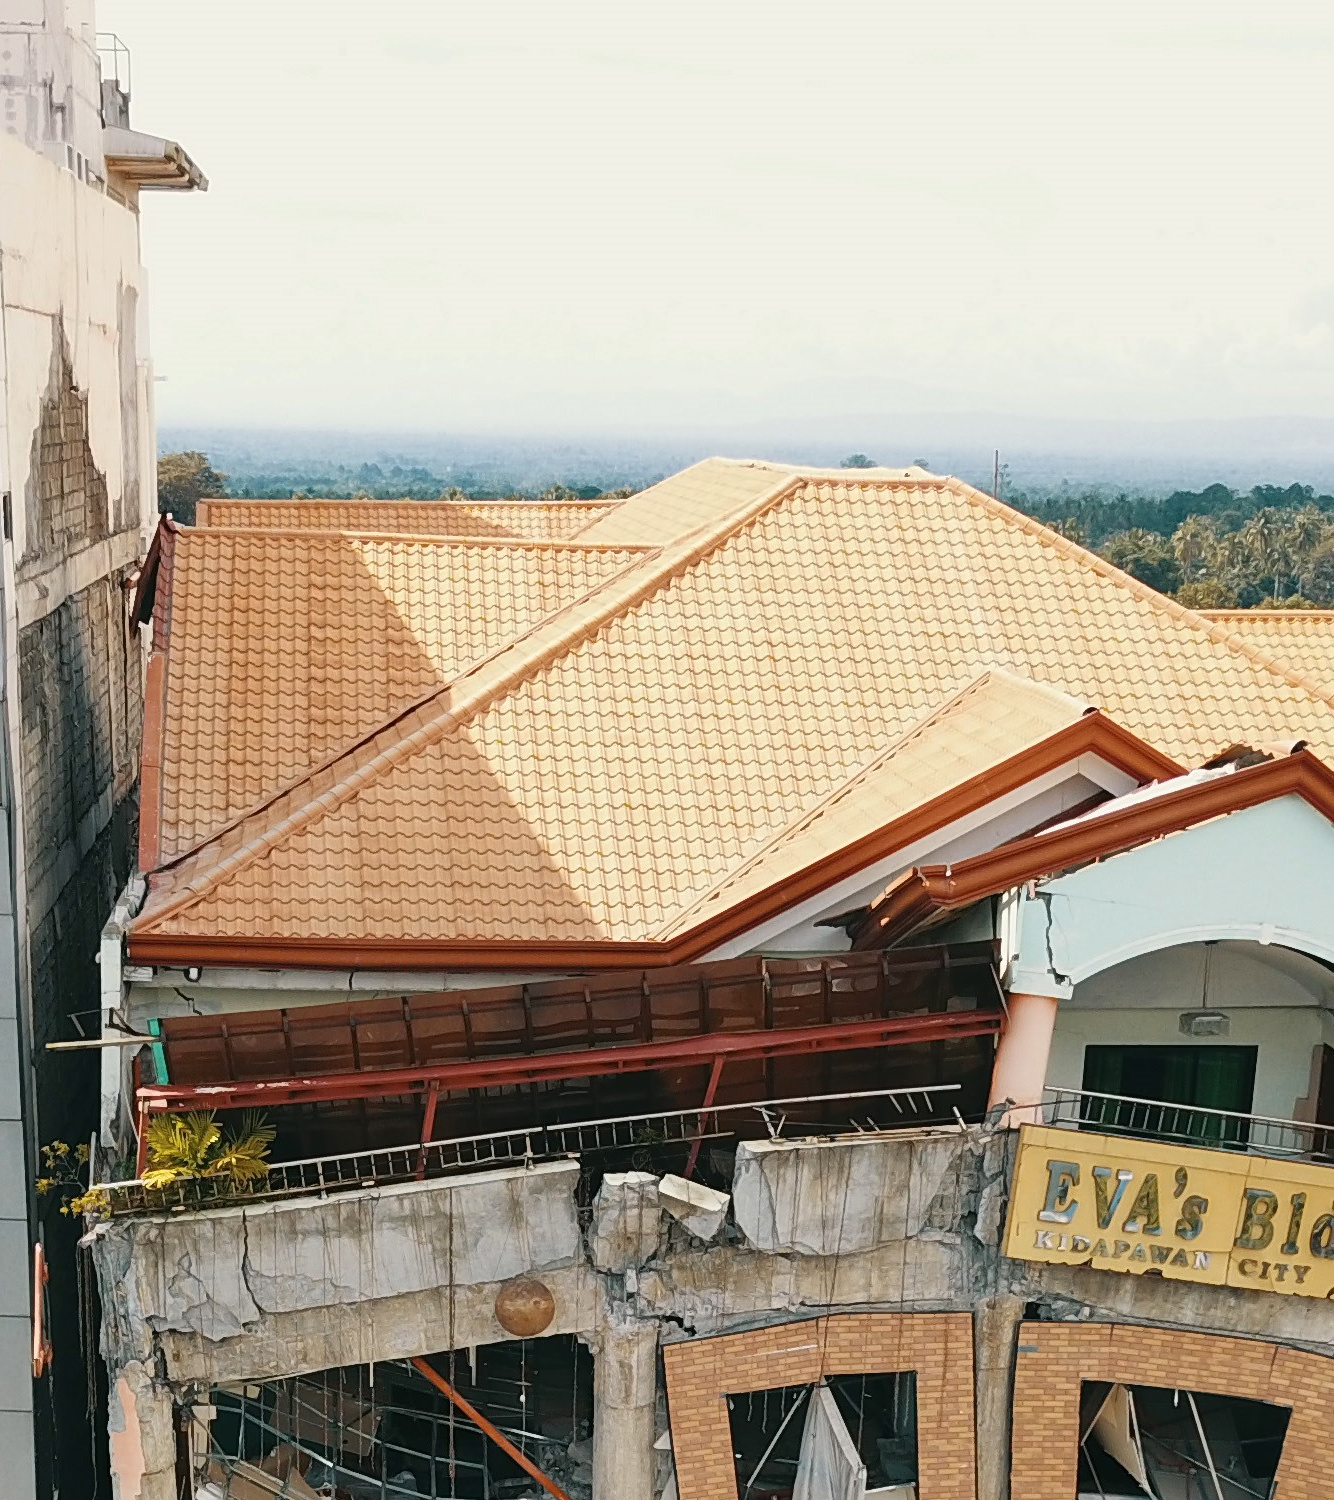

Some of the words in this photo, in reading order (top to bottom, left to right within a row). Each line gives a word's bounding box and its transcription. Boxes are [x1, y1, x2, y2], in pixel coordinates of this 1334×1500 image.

[1037, 1159, 1209, 1241] EVA's
[1032, 1230, 1211, 1271] KIDAPAWAN
[1238, 1258, 1312, 1284] CITY
